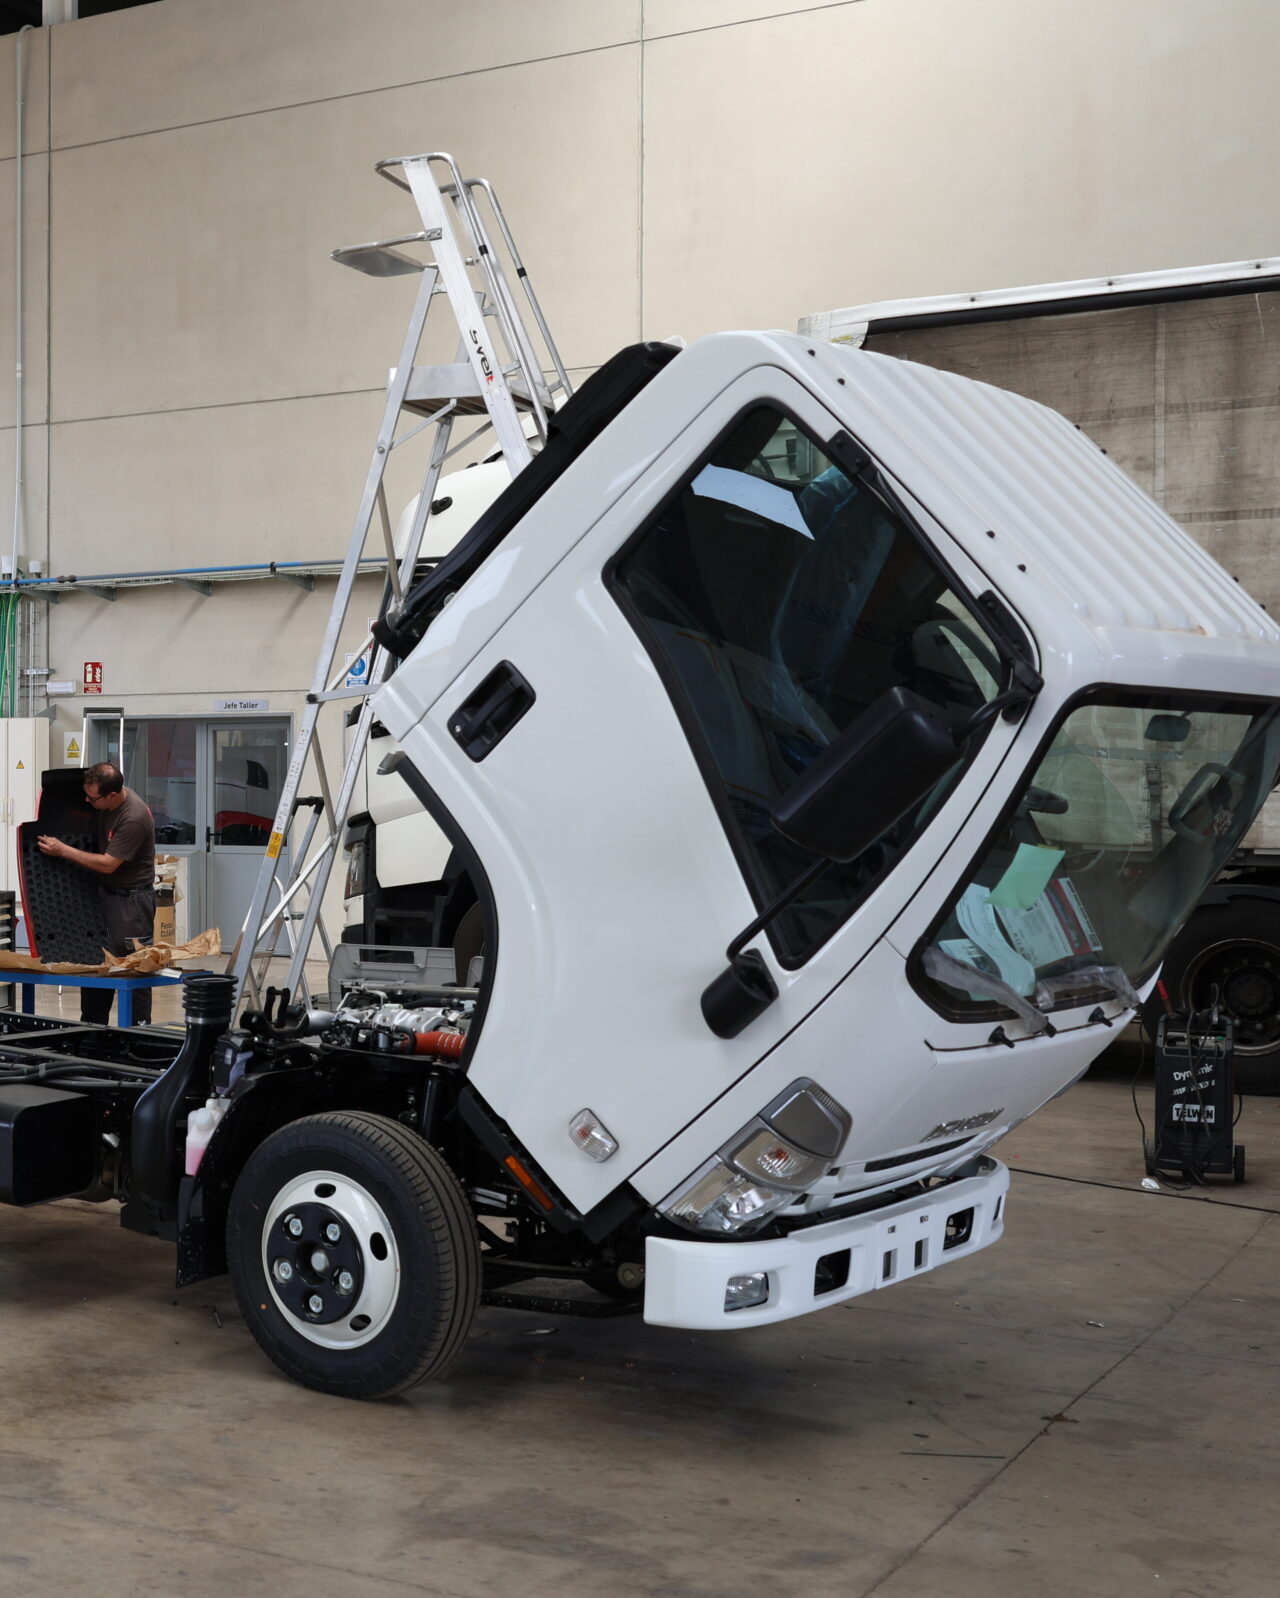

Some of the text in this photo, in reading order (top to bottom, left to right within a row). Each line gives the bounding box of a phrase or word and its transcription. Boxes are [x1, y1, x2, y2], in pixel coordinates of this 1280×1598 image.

[223, 701, 259, 710] Jefe Taller
[1173, 1107, 1213, 1120] TELWN
